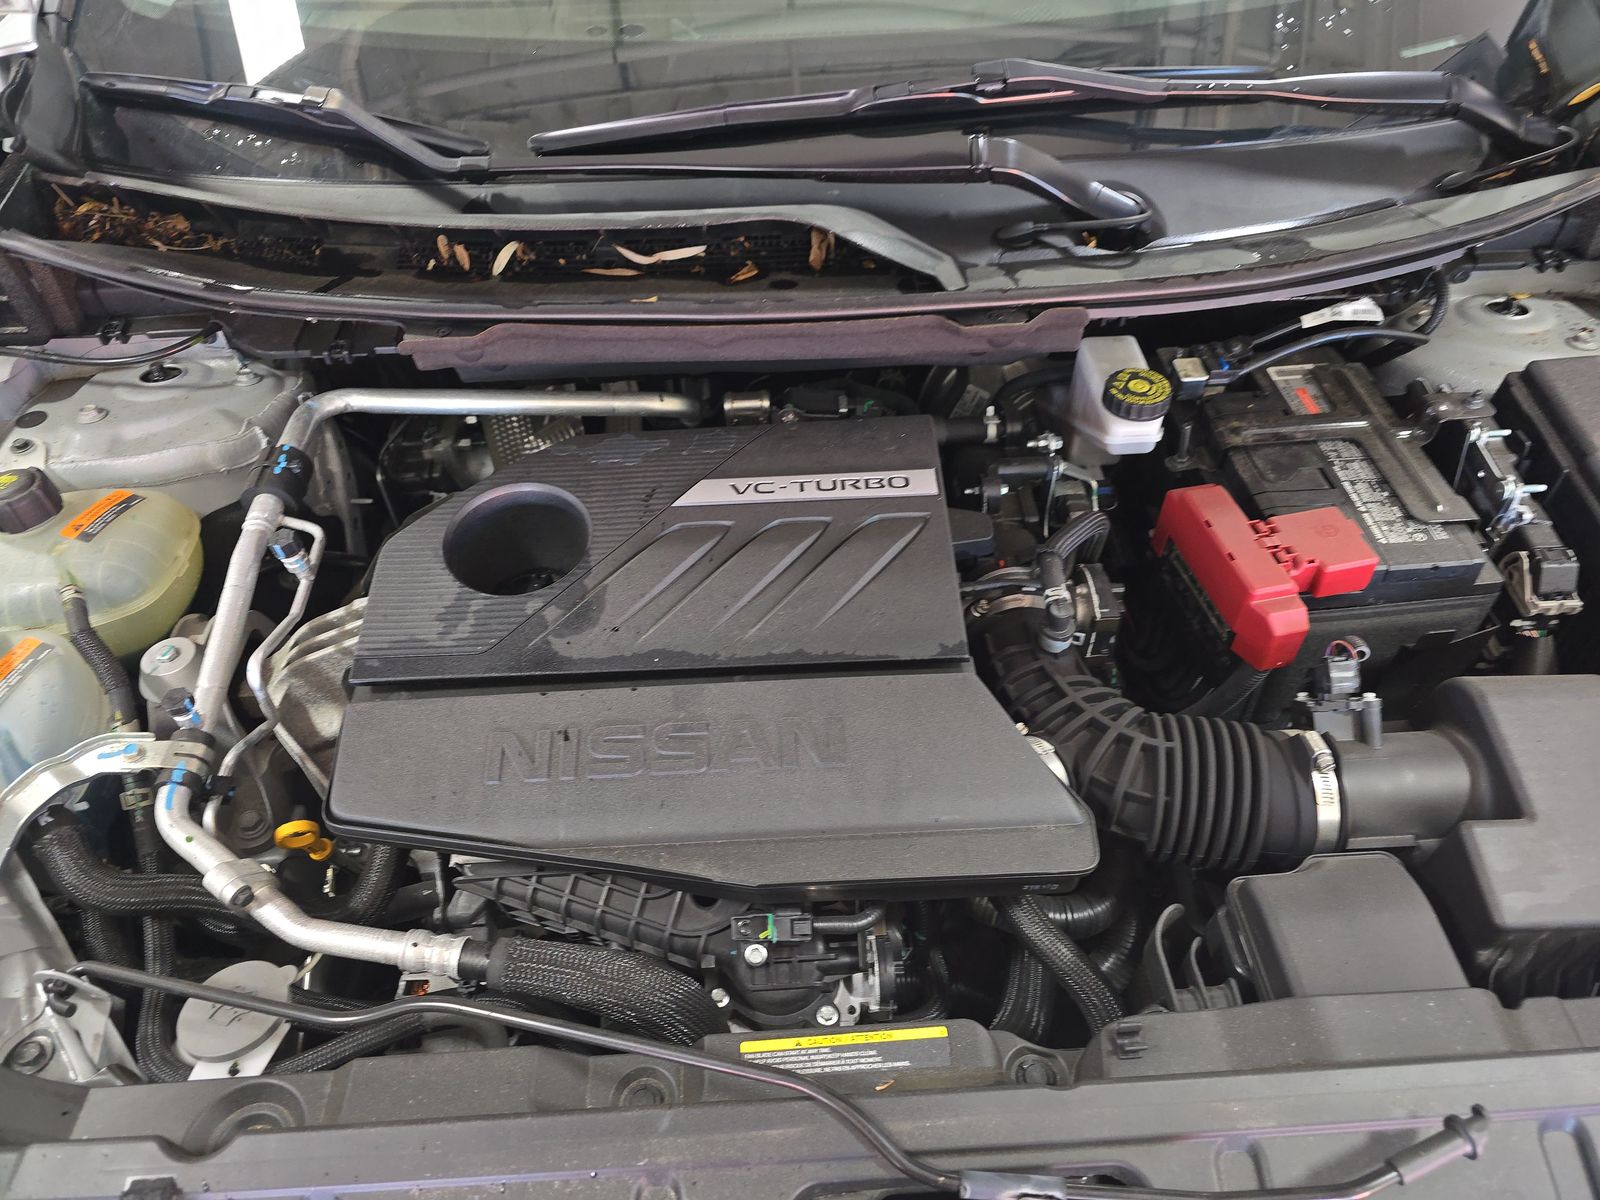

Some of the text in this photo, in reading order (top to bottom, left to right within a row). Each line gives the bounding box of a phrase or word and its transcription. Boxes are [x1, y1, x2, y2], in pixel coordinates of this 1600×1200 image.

[729, 475, 910, 495] VC-TURBO
[484, 715, 849, 785] NISSAN
[808, 1036, 843, 1045] CAUTION
[851, 1031, 893, 1042] ATTENTION
